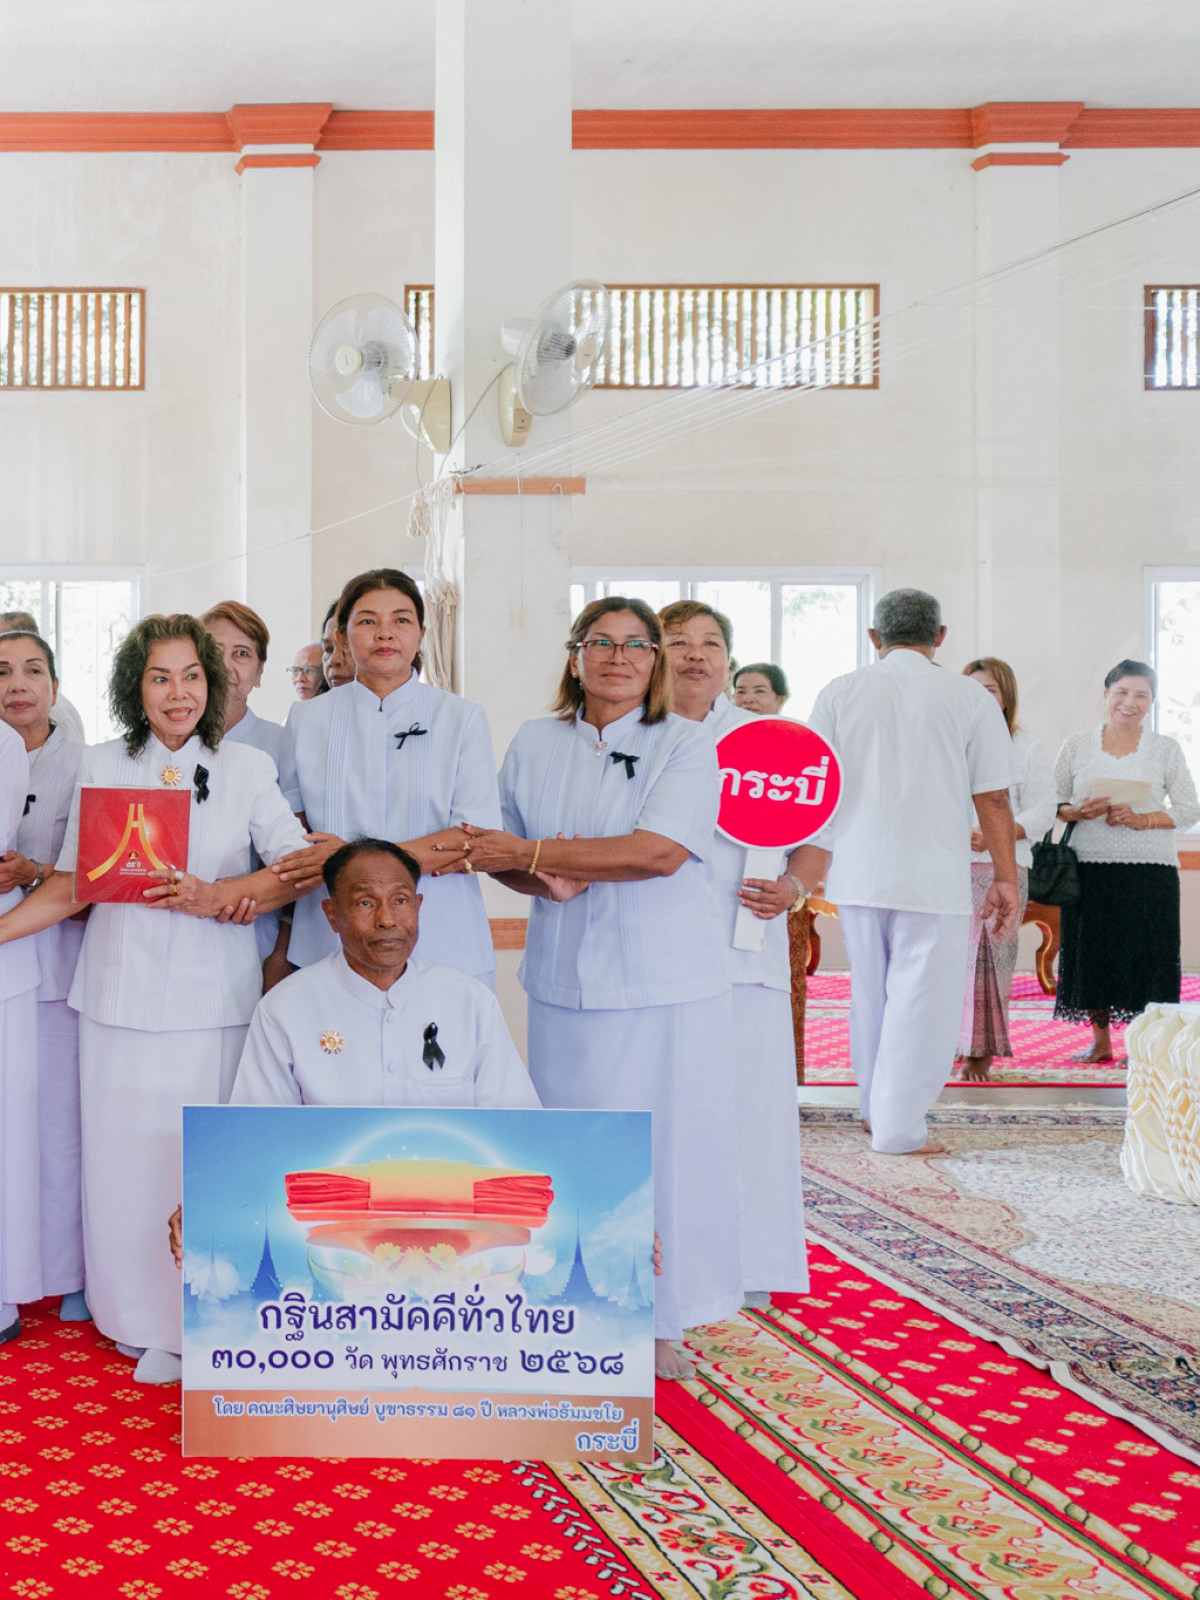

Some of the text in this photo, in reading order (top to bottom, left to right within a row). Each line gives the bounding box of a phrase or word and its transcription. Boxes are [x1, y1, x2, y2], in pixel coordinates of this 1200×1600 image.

[718, 756, 830, 806] กระบี่
[260, 1284, 575, 1341] กฐินสามัคคีทั่วไทย
[212, 1346, 624, 1379] ๓๐,๐๐๐ วัด พุทธศักราช ๒๕๖๘
[214, 1397, 623, 1422] โดย คณะศิษยานุศิษย์ บูชาธรรม ๘๑ ปี หลวงพ่อธัมมชโย
[576, 1418, 638, 1451] กระบี่
